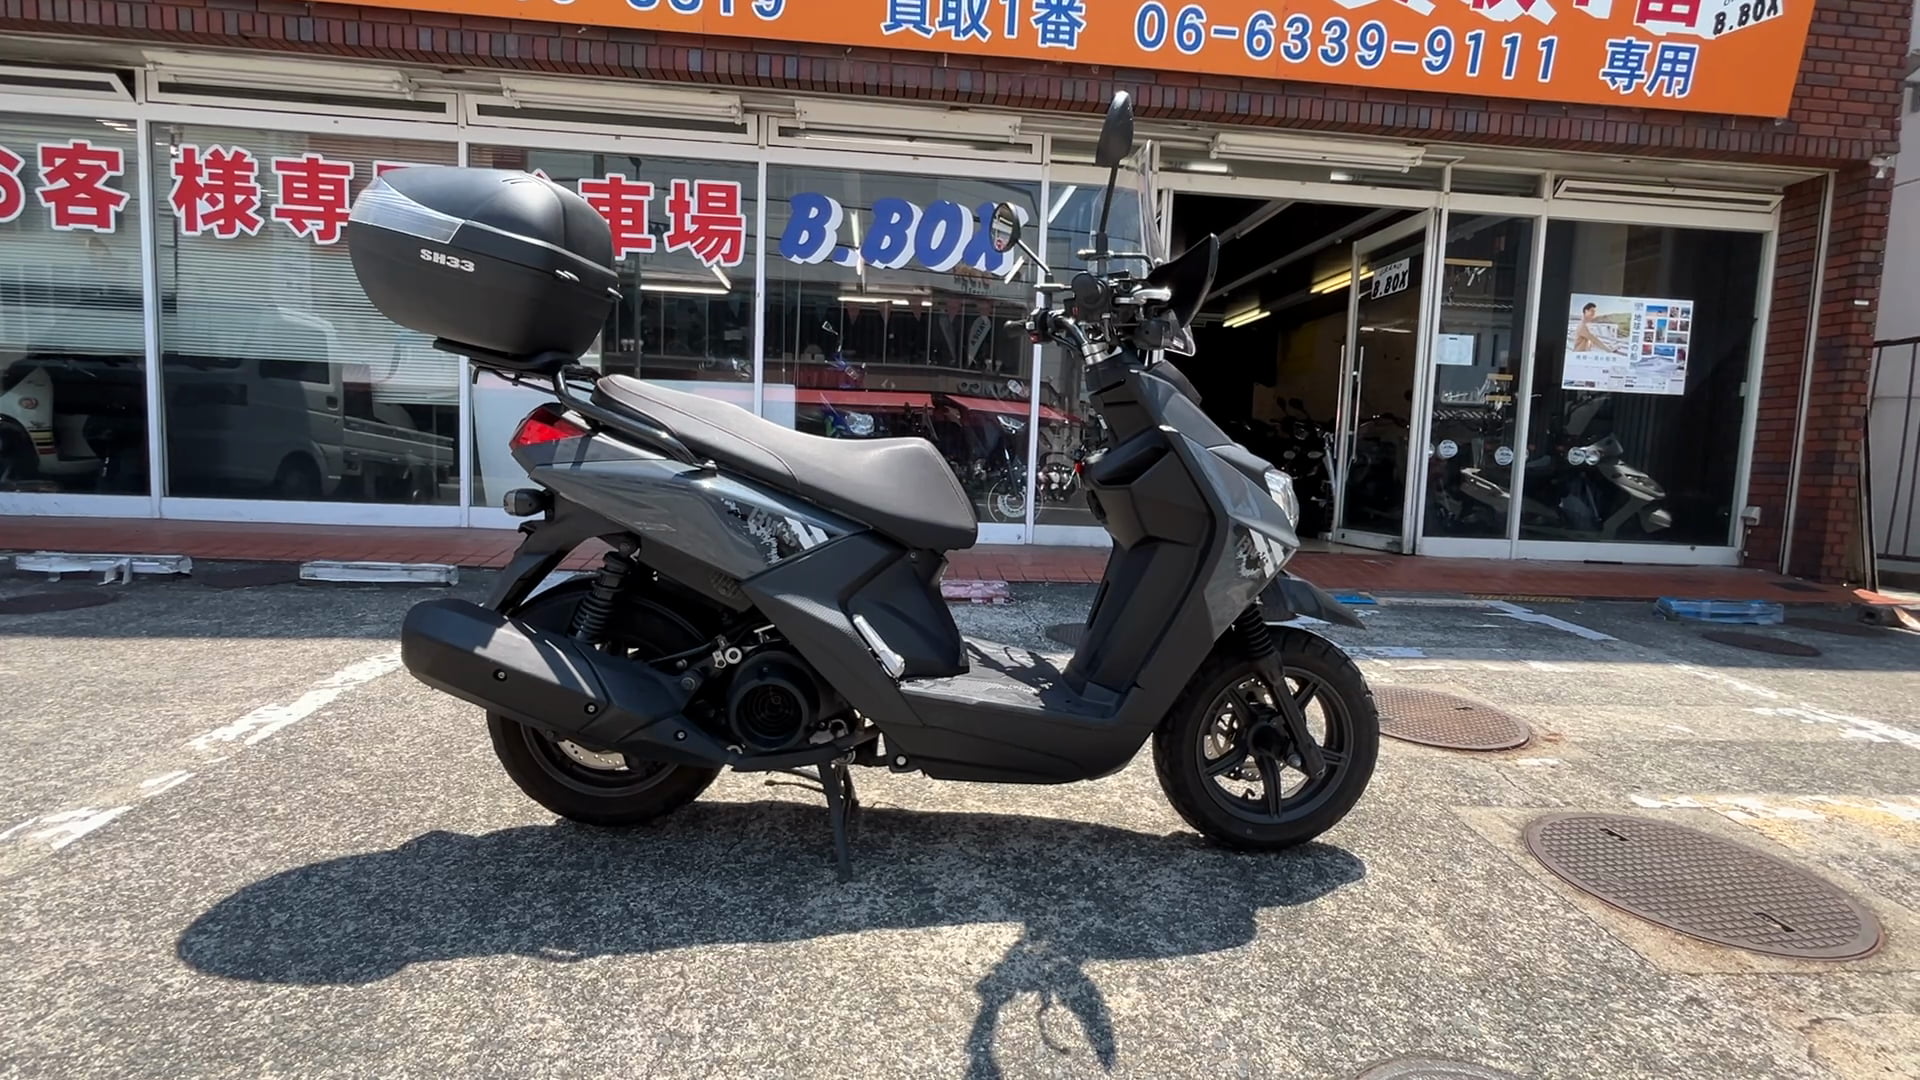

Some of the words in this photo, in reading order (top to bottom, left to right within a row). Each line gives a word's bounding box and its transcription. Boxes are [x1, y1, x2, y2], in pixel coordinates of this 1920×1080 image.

[1713, 0, 1778, 35] B.BOX
[1134, 1, 1559, 83] 06-6339-9111
[1599, 36, 1699, 97] 専用
[780, 191, 1025, 276] B.BOX
[419, 248, 476, 273] SH33
[1372, 270, 1409, 297] B.BOX
